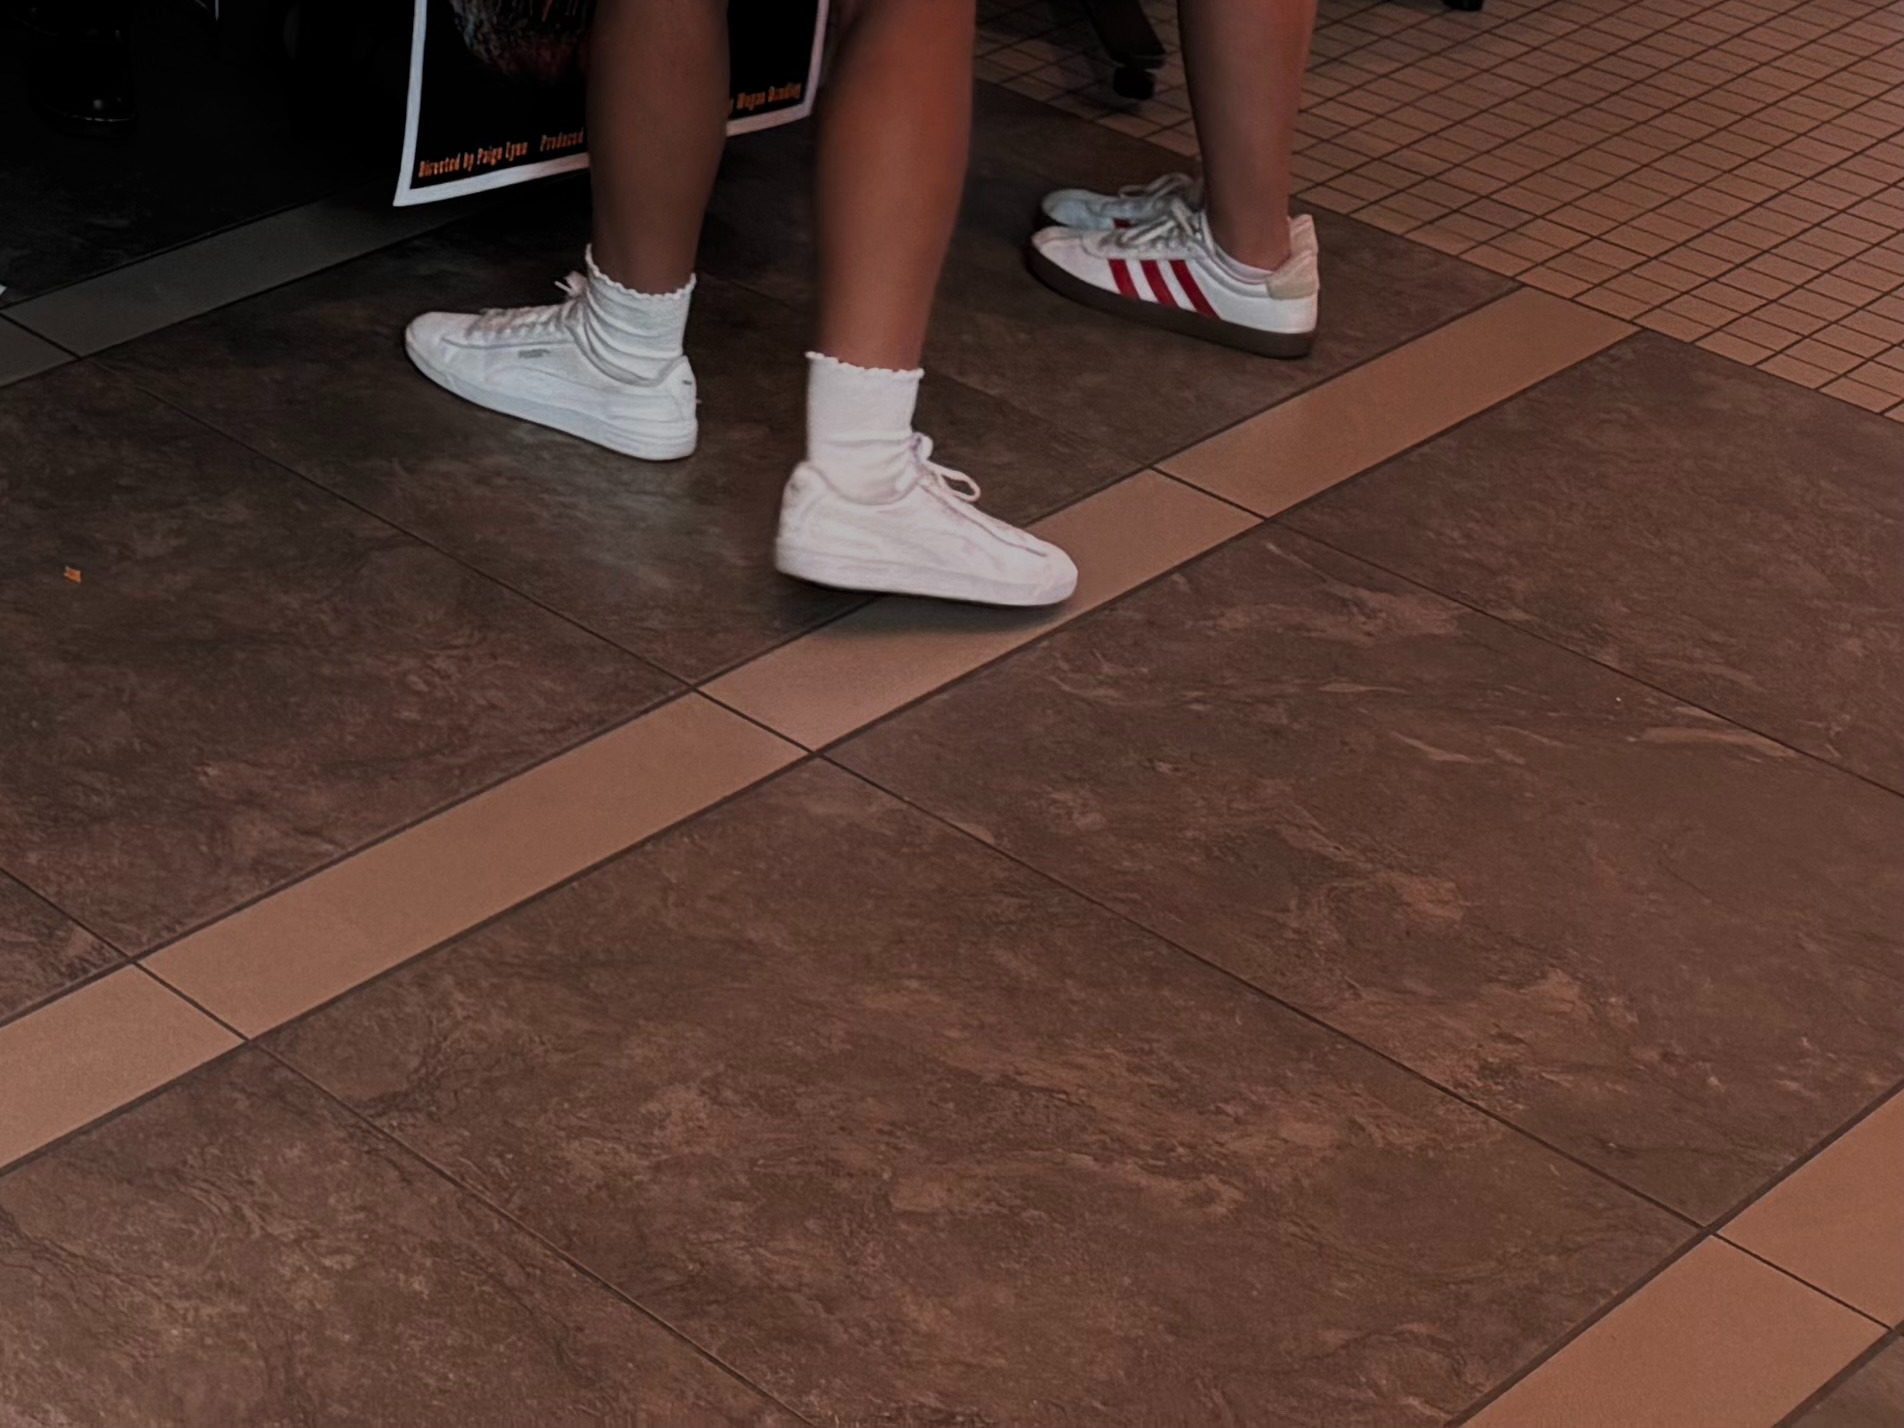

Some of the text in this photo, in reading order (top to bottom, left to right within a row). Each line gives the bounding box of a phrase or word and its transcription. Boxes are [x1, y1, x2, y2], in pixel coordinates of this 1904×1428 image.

[418, 127, 585, 178] Directed by Paige Lynn Produced
